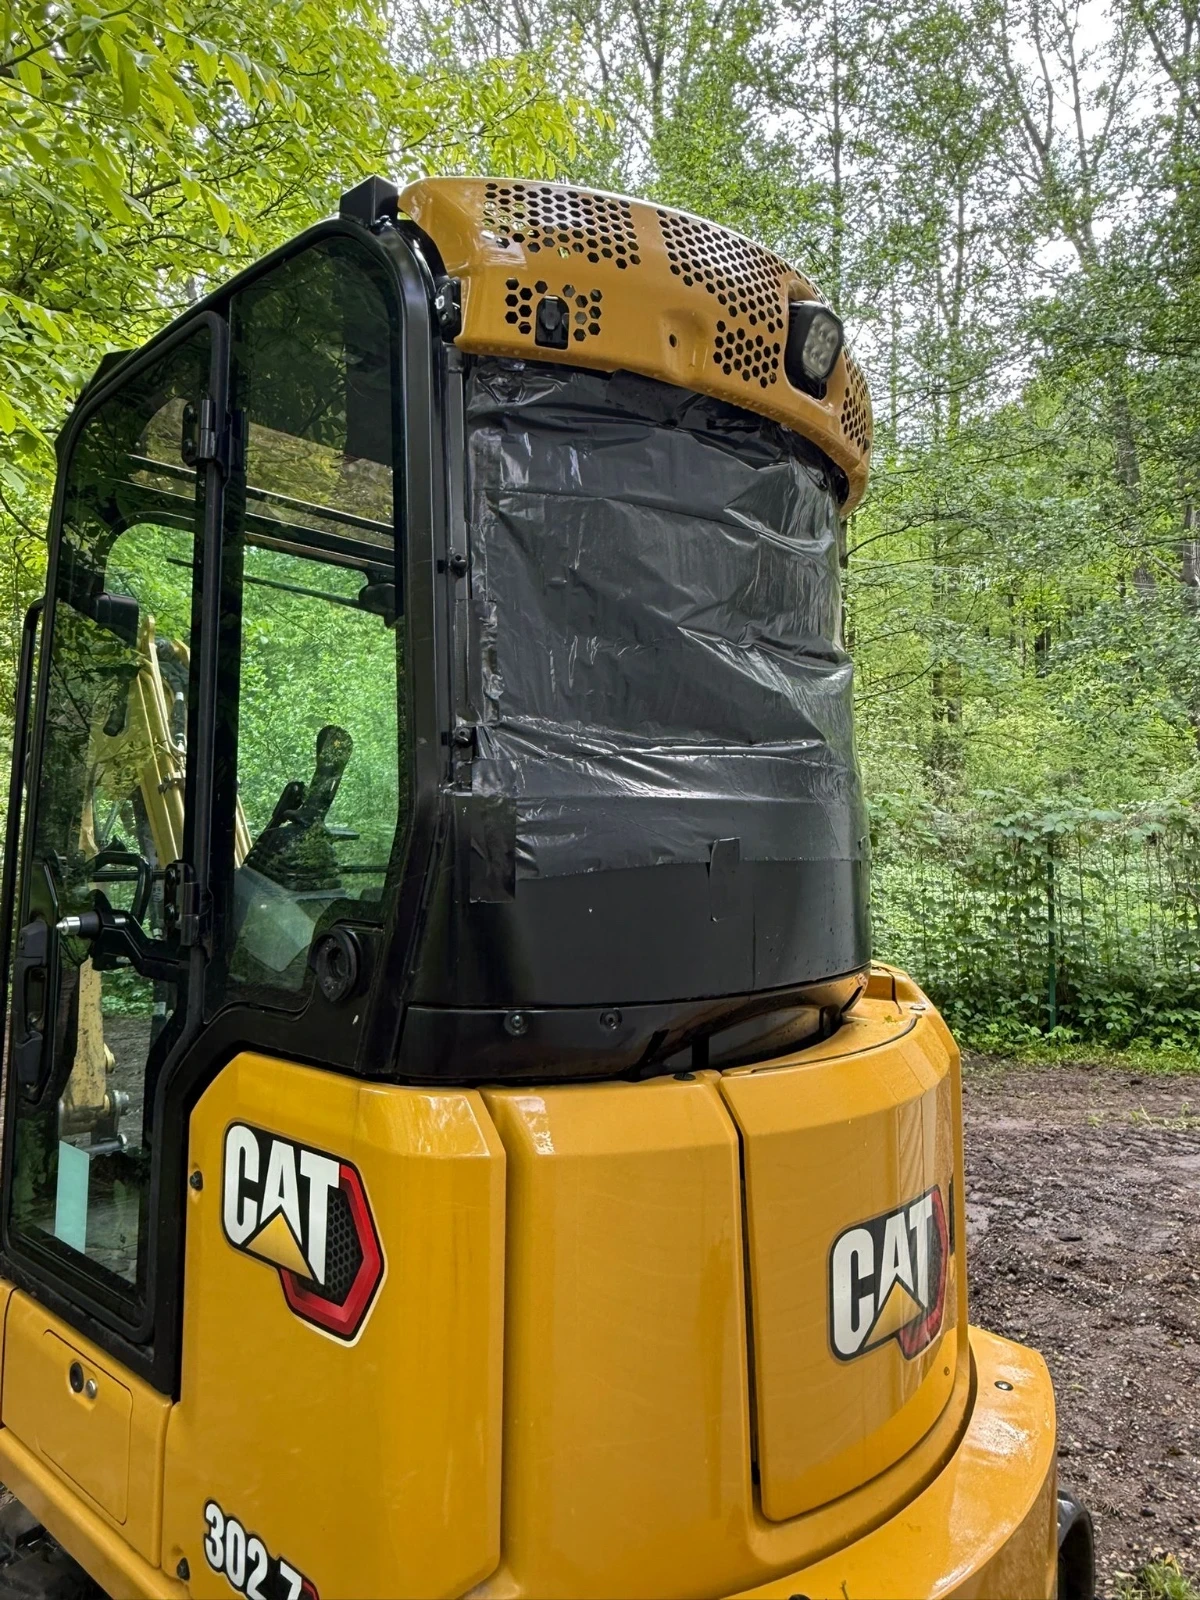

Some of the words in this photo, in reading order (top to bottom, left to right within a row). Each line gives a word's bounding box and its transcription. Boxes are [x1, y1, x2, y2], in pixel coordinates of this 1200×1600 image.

[224, 1125, 340, 1286] CAT
[833, 1193, 933, 1355] CAT
[205, 1503, 302, 1600] 3027
